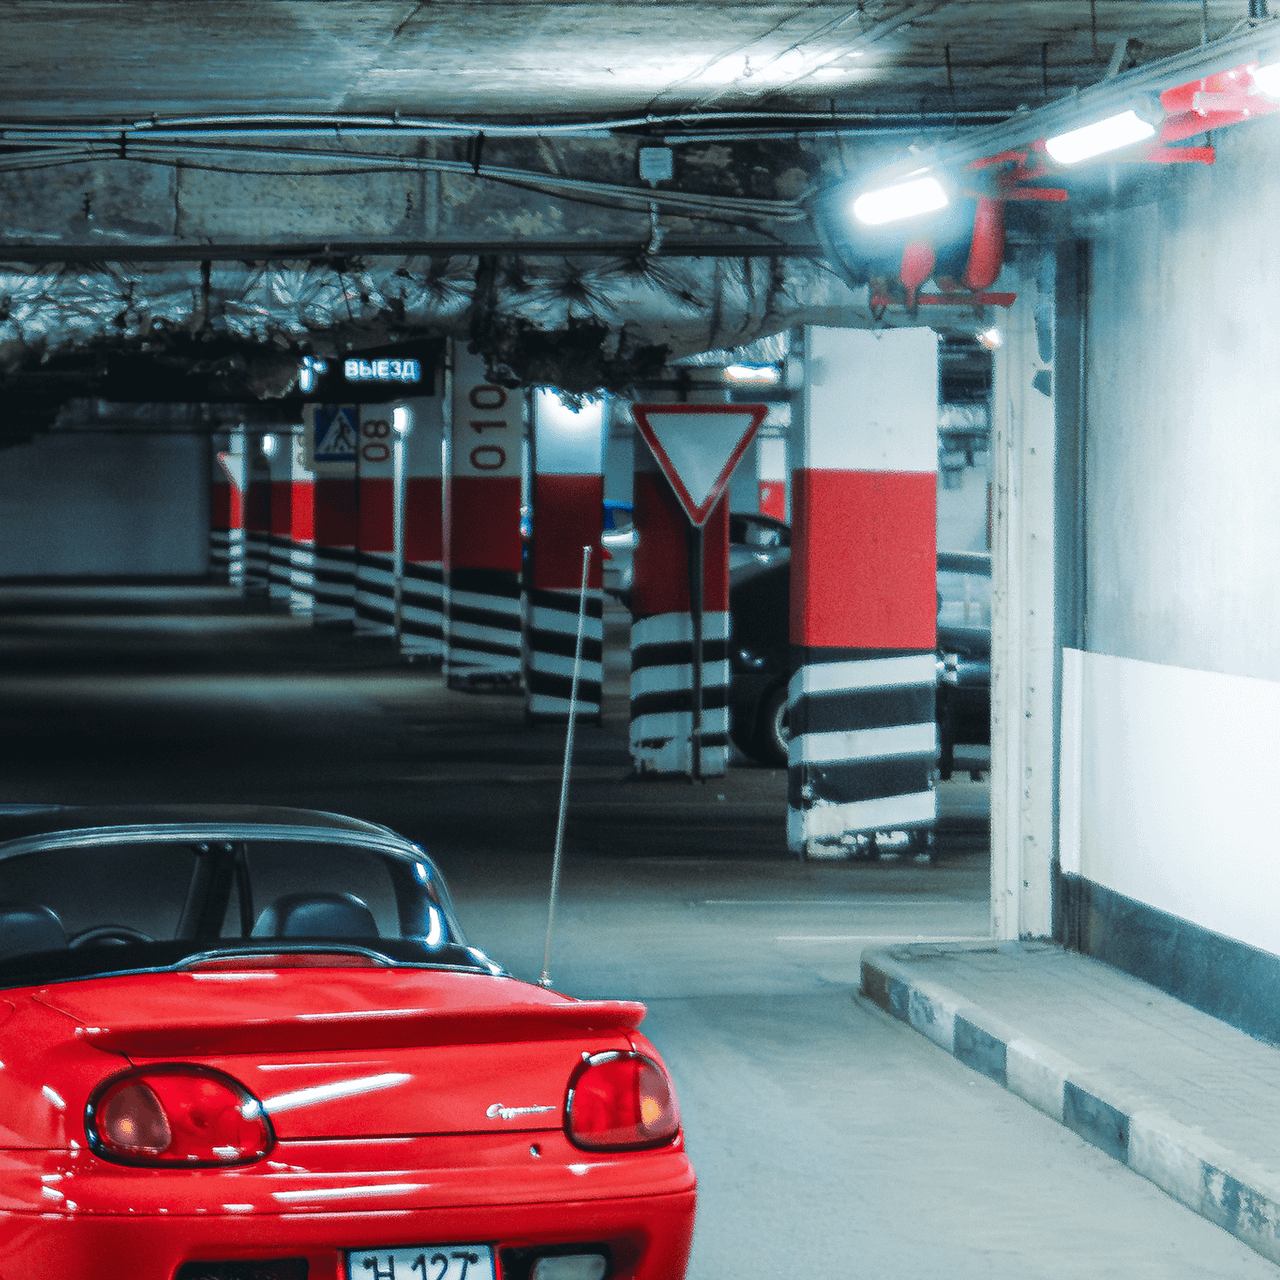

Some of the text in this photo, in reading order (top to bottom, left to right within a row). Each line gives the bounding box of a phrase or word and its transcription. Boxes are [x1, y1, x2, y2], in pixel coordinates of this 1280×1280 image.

[344, 359, 420, 381] ВЫЕЗД
[362, 420, 390, 462] 08
[470, 384, 506, 470] 010
